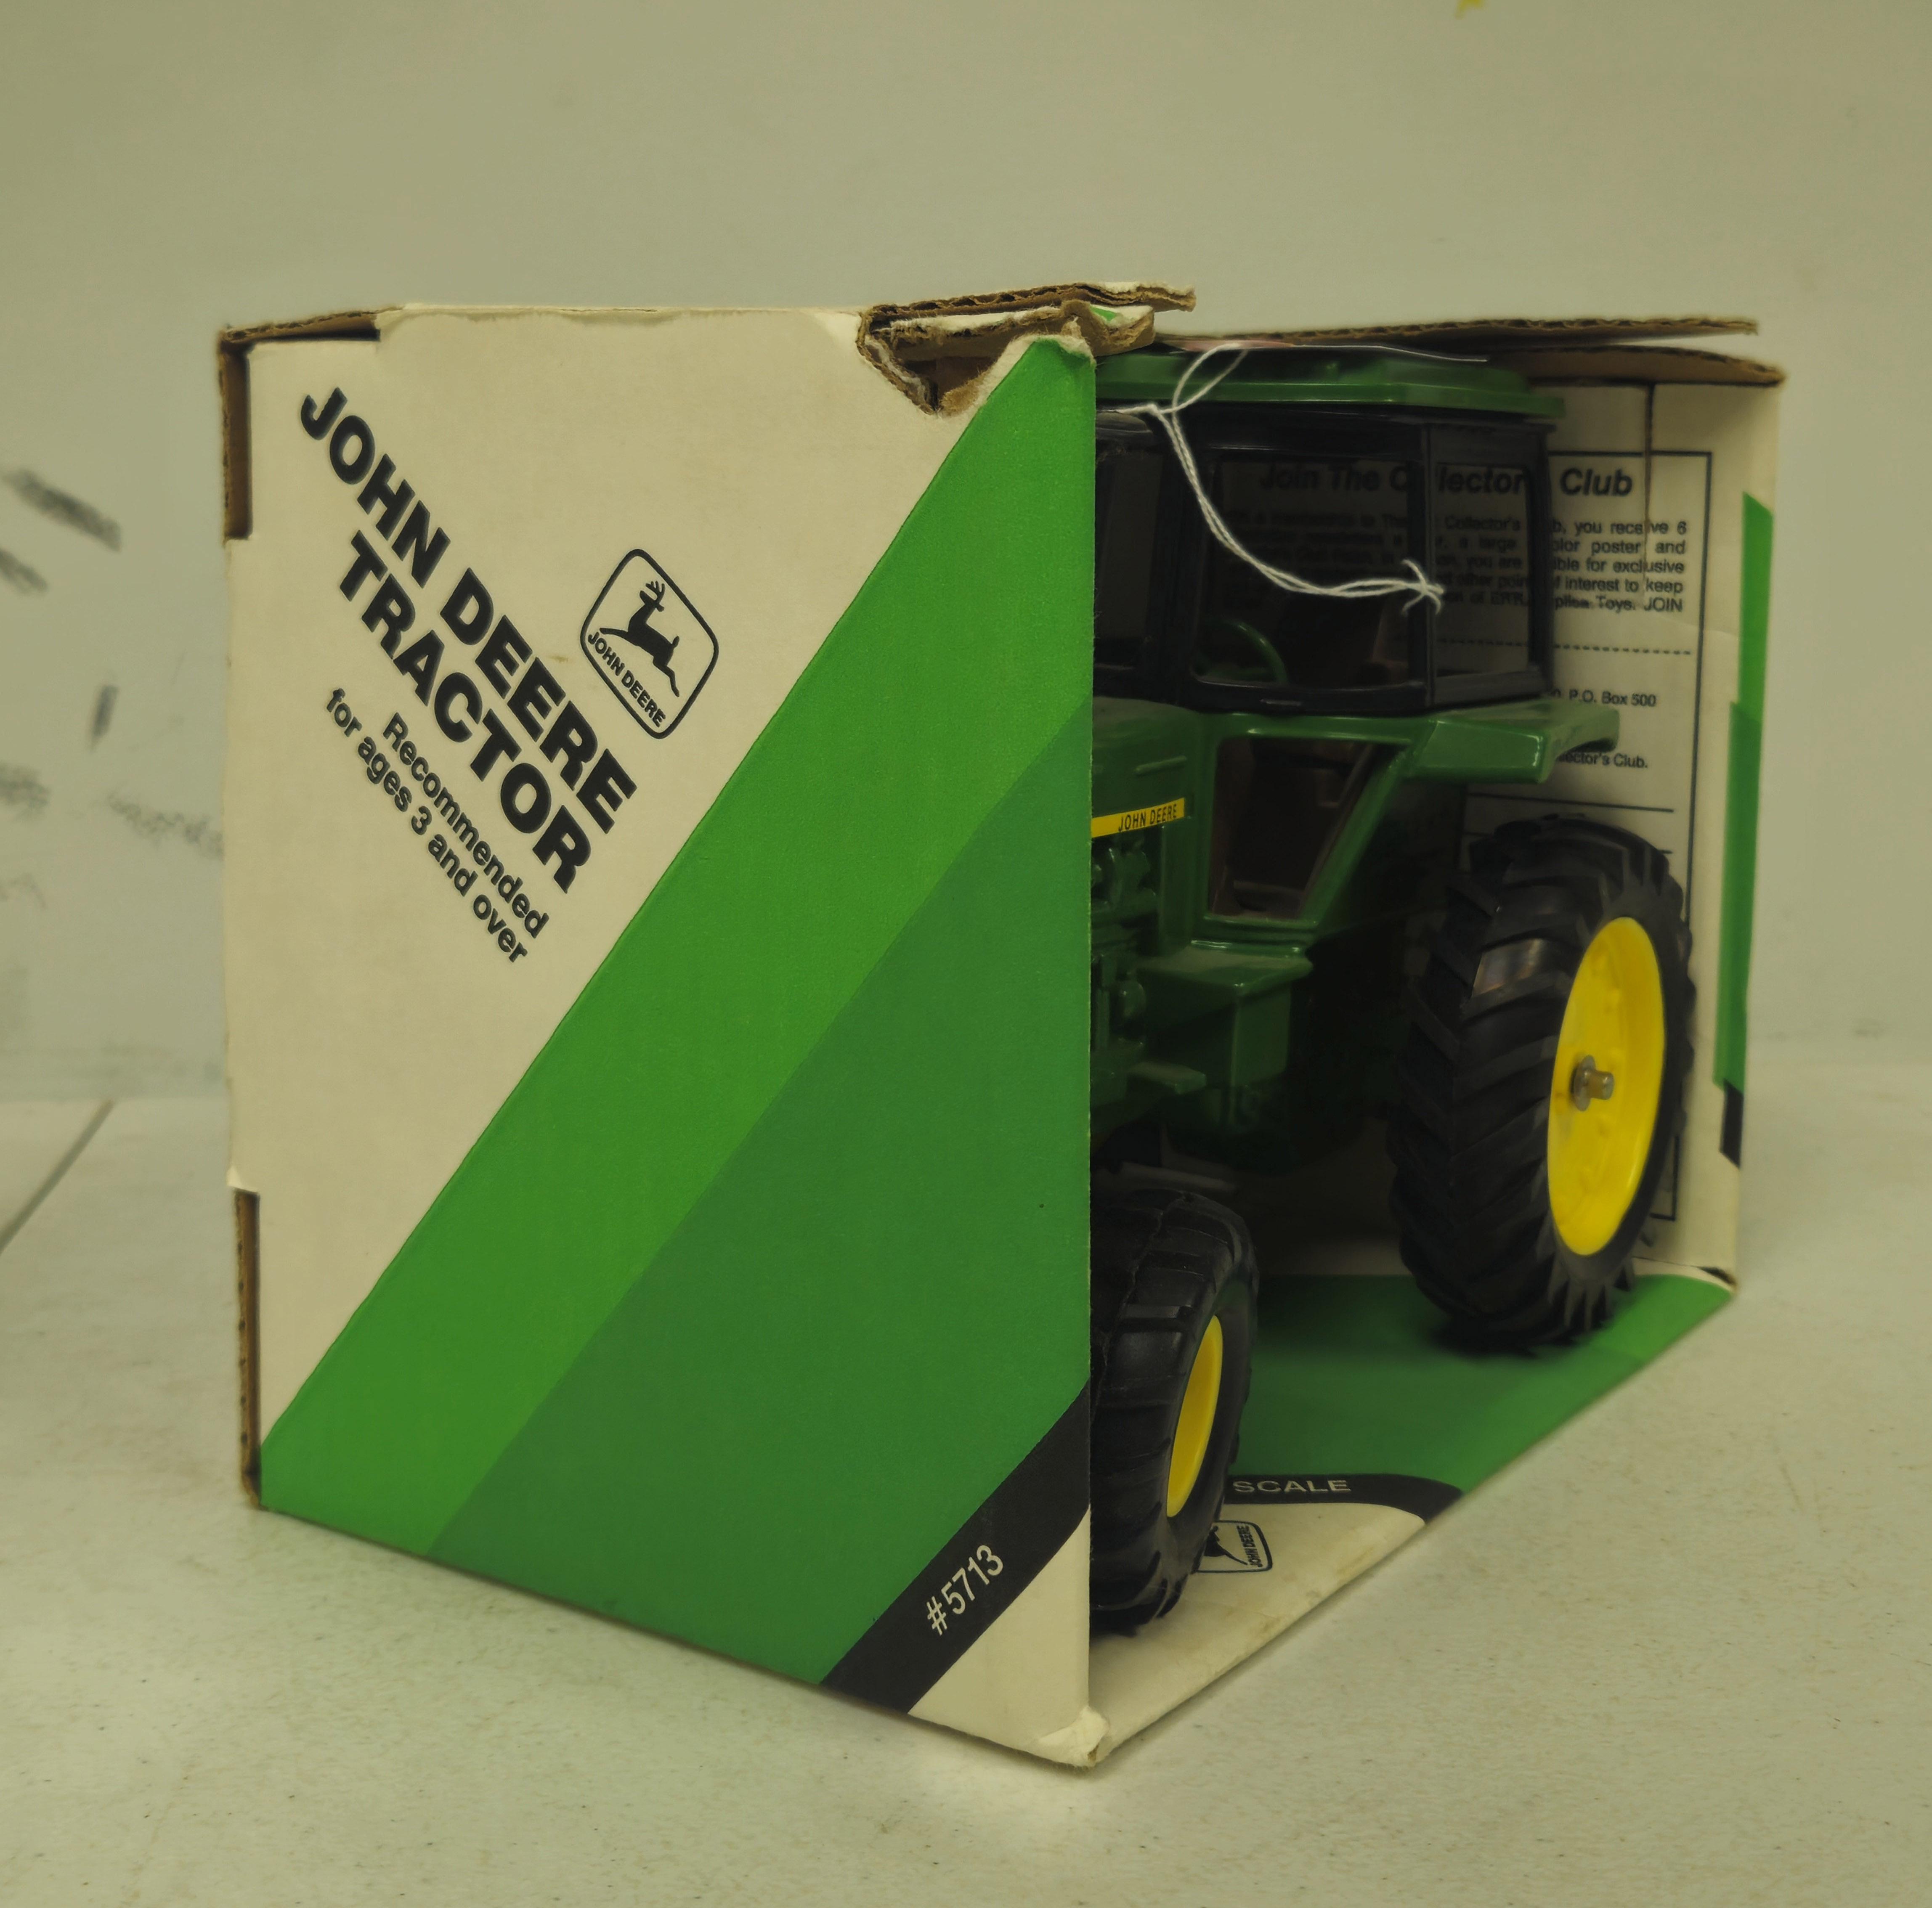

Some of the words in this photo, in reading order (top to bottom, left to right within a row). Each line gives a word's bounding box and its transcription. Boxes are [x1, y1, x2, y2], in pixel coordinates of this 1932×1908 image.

[1330, 465, 1380, 491] The
[1560, 467, 1632, 496] Club
[1575, 522, 1602, 536] you
[1677, 521, 1687, 535] 6
[1591, 540, 1641, 556] poster
[1655, 540, 1685, 554] and
[1585, 557, 1607, 572] for
[1613, 559, 1684, 573] exclusive
[1565, 576, 1619, 592] interest
[1624, 578, 1639, 592] to
[1645, 578, 1683, 596] keep
[300, 387, 451, 588] JOHN
[440, 567, 637, 834] DEERE
[1644, 596, 1683, 612] JOIN
[588, 632, 625, 676] JOHN
[621, 670, 666, 728] DEERE
[1569, 689, 1598, 704] P.O.
[1601, 691, 1628, 705] Box
[1631, 693, 1656, 707] 500
[340, 530, 591, 894] TRACTOR
[1614, 753, 1648, 768] Club.
[326, 688, 362, 737] for
[358, 736, 412, 812] ages
[411, 806, 432, 835] 3
[428, 834, 478, 897] and
[473, 894, 528, 962] over
[382, 712, 549, 939] Recommended
[1118, 811, 1146, 832] JOHN
[1149, 803, 1177, 824] DEERE
[1233, 1479, 1351, 1493] SCALE
[1244, 1548, 1263, 1568] JOHN
[926, 1545, 1003, 1636] #5713
